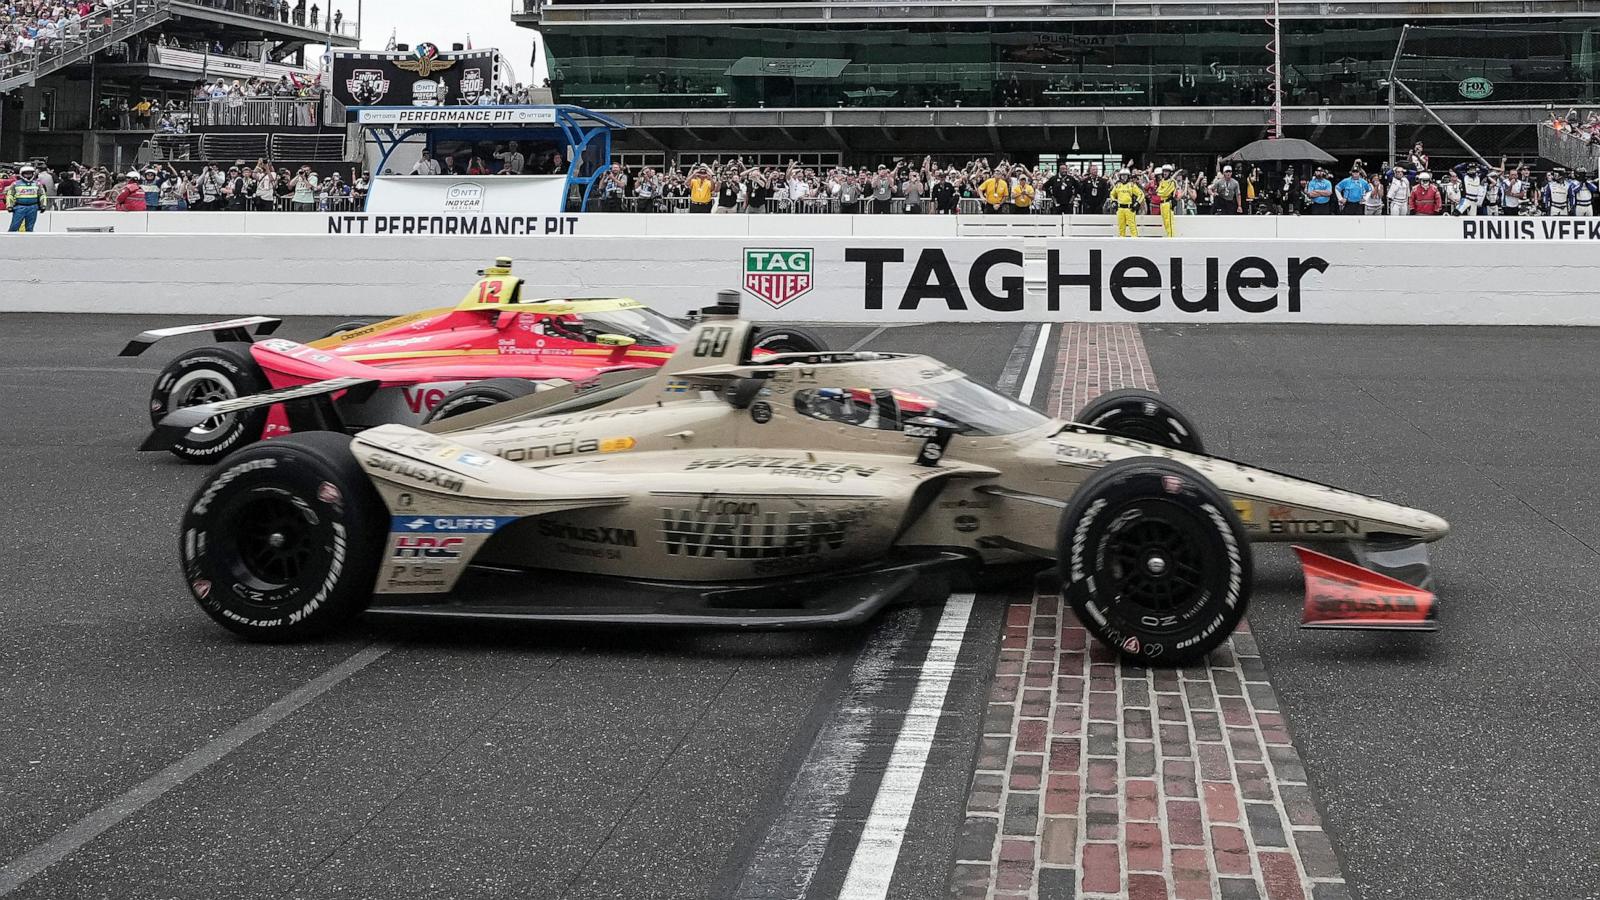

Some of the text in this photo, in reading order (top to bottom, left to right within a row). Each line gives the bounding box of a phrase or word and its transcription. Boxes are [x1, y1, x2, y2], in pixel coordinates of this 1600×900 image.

[463, 80, 480, 91] 500
[1466, 82, 1485, 91] FOX
[400, 111, 514, 121] PERFORMANCE PIT
[328, 216, 578, 234] NTT PERFORMANCE PIT
[1463, 220, 1535, 239] RINUS
[750, 253, 806, 270] TAG
[479, 280, 503, 303] 12
[748, 275, 808, 303] HEUER
[499, 346, 541, 355] V-Power
[694, 326, 733, 357] 60
[494, 438, 599, 462] onda
[367, 453, 465, 493] SiriusXM
[769, 468, 844, 484] RADIO
[434, 518, 497, 530] CLIFFS
[1269, 519, 1360, 534] BITCOIN
[660, 507, 850, 561] WALLEN
[393, 536, 465, 558] HRC
[289, 521, 348, 625] FIREHAWK
